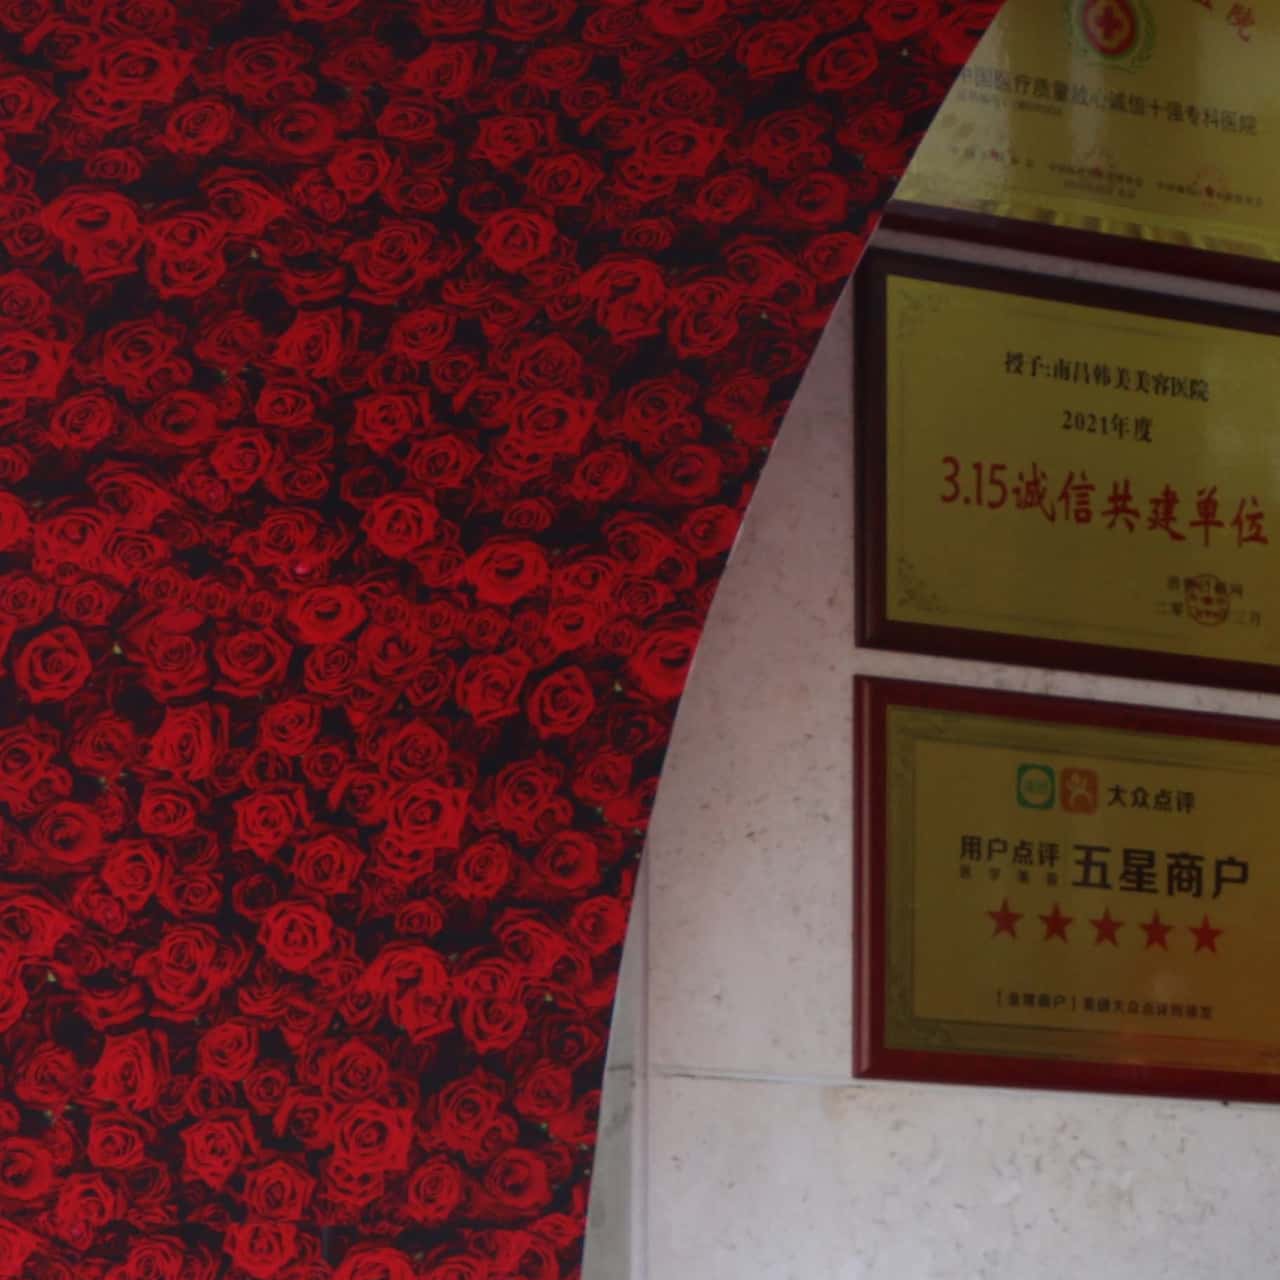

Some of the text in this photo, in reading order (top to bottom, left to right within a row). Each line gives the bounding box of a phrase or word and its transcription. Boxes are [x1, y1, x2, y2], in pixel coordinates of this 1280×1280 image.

[1061, 410, 1153, 444] 2021年度
[941, 455, 1269, 547] 3.15诚信共建单位
[1107, 785, 1196, 815] 大众点评
[960, 835, 1061, 868] 用户点评
[1072, 843, 1250, 899] 五星商户
